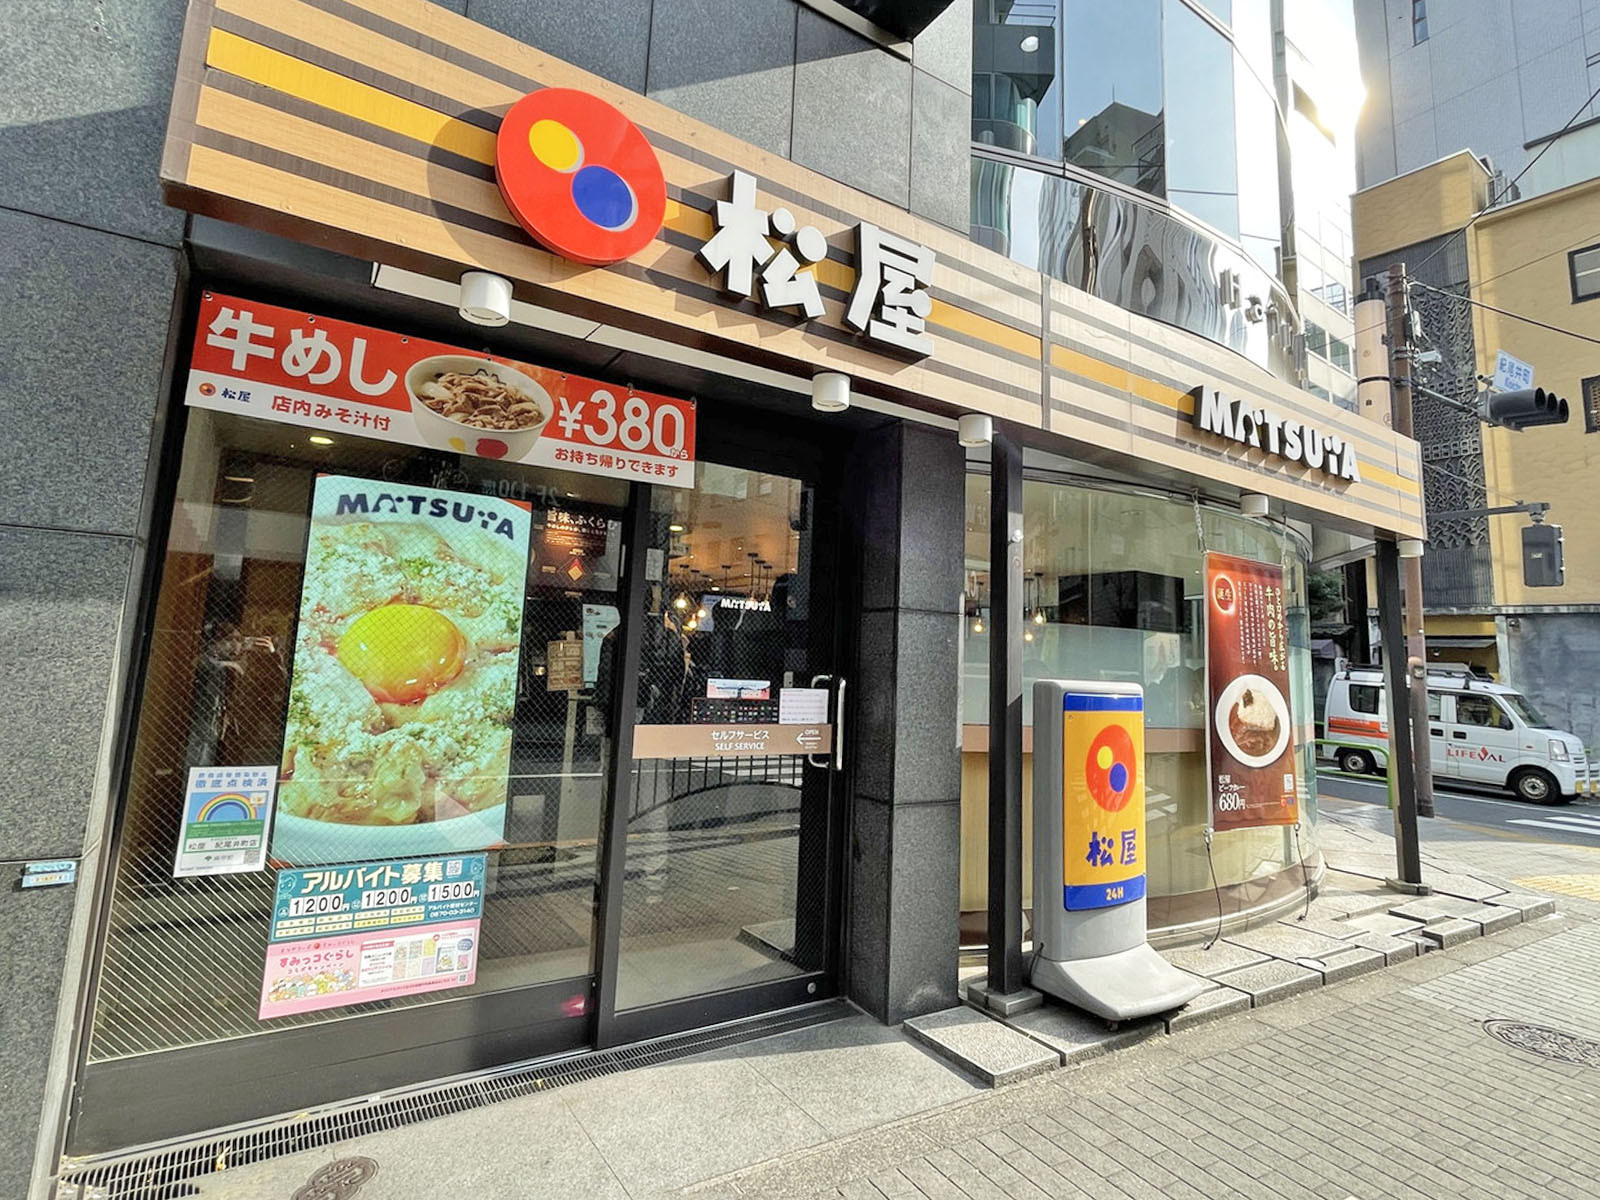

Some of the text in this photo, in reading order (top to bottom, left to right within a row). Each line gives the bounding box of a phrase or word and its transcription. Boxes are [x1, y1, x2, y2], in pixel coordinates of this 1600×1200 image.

[696, 168, 937, 356] 松屋
[206, 306, 398, 397] 牛めし
[221, 387, 252, 404] 松屋
[271, 395, 392, 432] 店内みそ汁付
[558, 389, 685, 456] ¥380
[1199, 385, 1362, 483] MATSUYA
[554, 447, 679, 478] お持ち帰りできます
[336, 492, 515, 540] MATSUYA
[711, 730, 770, 741] セルフサービス
[714, 742, 765, 751] SELF SERVICE
[1219, 792, 1246, 811] 680円
[1085, 828, 1138, 868] 松屋
[300, 861, 444, 894] アルバイト募集
[1105, 885, 1125, 901] 24H
